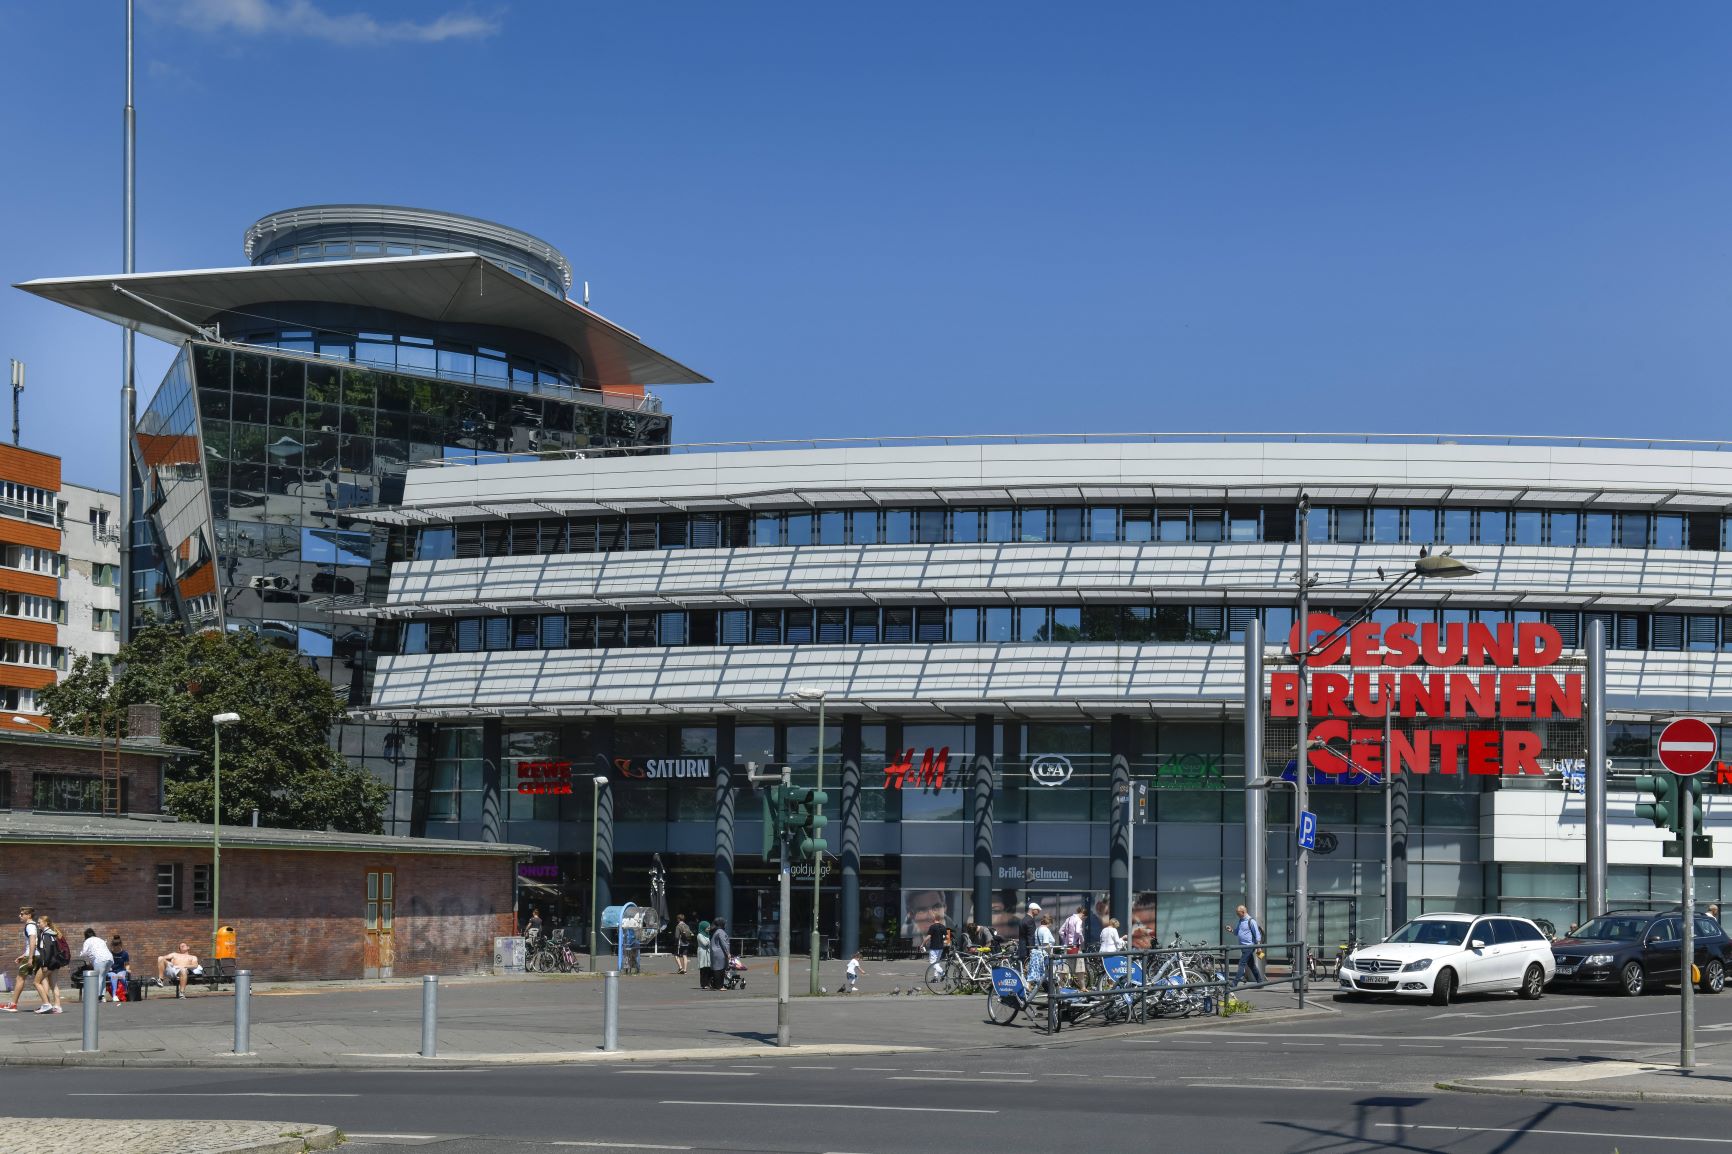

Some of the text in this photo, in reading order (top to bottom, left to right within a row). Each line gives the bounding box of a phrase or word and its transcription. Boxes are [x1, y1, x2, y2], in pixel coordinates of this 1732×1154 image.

[1289, 613, 1563, 667] GESUND
[1270, 673, 1582, 718] BRUNNEN
[1307, 720, 1545, 775] CENTER
[646, 759, 710, 778] SATURN
[884, 746, 949, 789] H&M
[1037, 762, 1065, 777] C&A
[517, 782, 573, 795] CENTER
[1302, 816, 1313, 845] P
[518, 864, 559, 876] ONUTS
[790, 863, 831, 877] goldjuge
